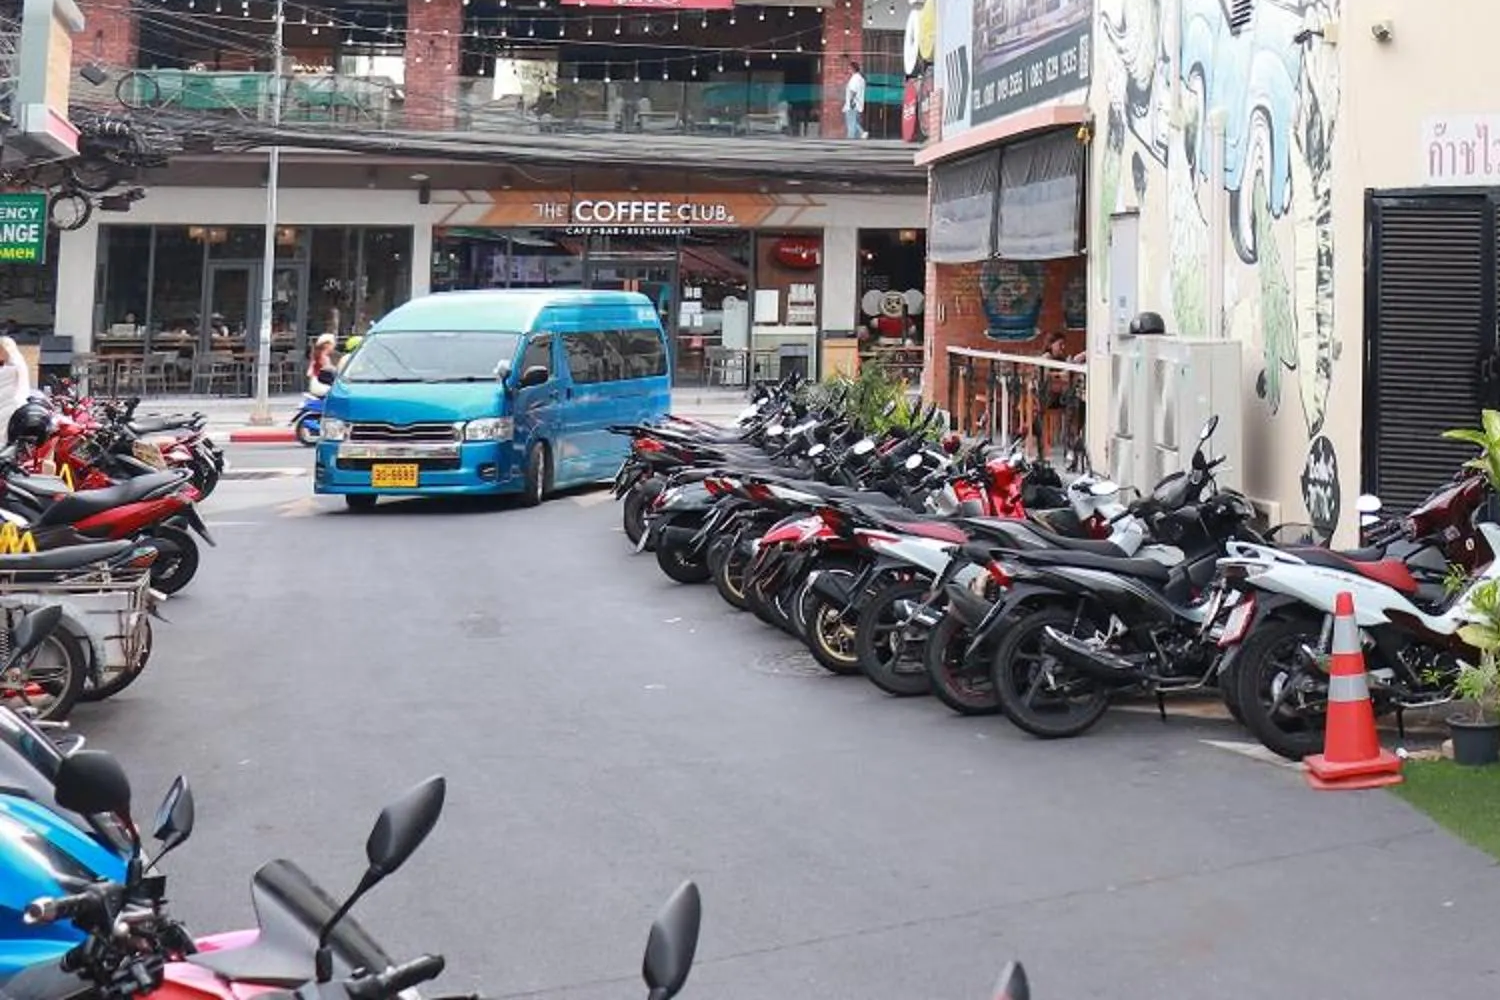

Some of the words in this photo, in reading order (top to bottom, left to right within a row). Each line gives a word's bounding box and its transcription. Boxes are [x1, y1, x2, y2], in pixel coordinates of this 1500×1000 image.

[532, 203, 568, 220] THE
[575, 201, 671, 223] COFFEE
[0, 223, 38, 243] NGE
